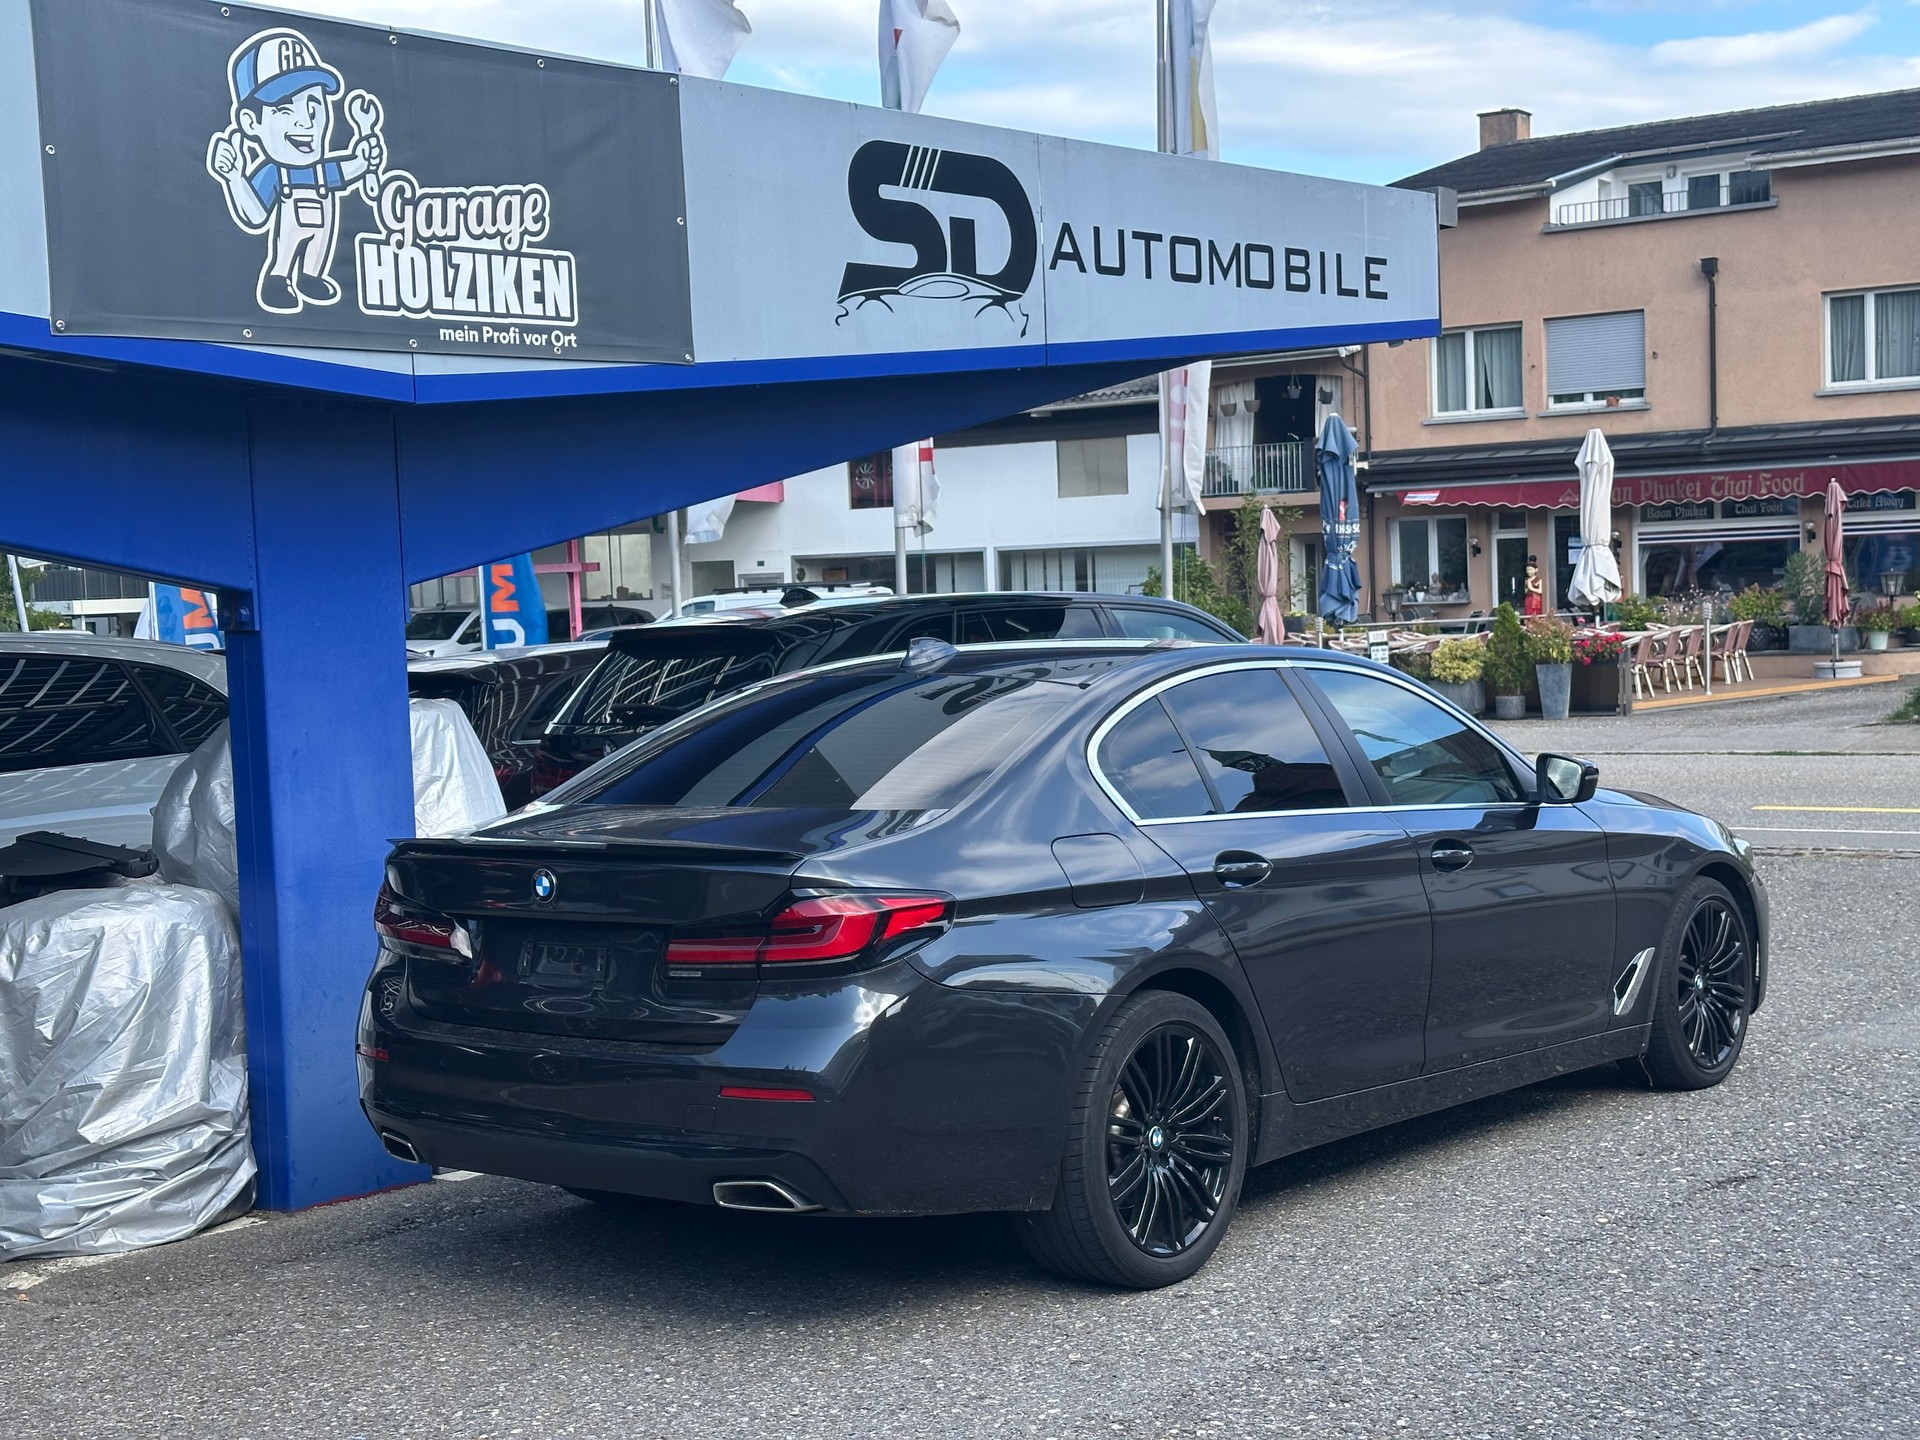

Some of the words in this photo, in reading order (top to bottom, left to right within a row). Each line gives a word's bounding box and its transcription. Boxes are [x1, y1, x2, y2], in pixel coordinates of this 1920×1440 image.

[278, 40, 306, 73] GB
[381, 180, 543, 253] Garage
[838, 139, 1037, 302] SD
[1049, 222, 1388, 300] AUTOMOBILE
[363, 243, 571, 317] HOLZIKEN
[439, 325, 479, 343] mein
[482, 326, 520, 345] Profi
[523, 332, 548, 346] vor
[551, 330, 577, 347] Ort
[1611, 486, 1633, 502] an
[1640, 478, 1702, 501] Phuket
[1711, 474, 1753, 497] Thai
[1759, 472, 1804, 494] Food
[1646, 508, 1672, 519] Baan
[1675, 505, 1707, 518] Phuket
[1735, 503, 1757, 515] Thai
[1760, 501, 1784, 514] Food
